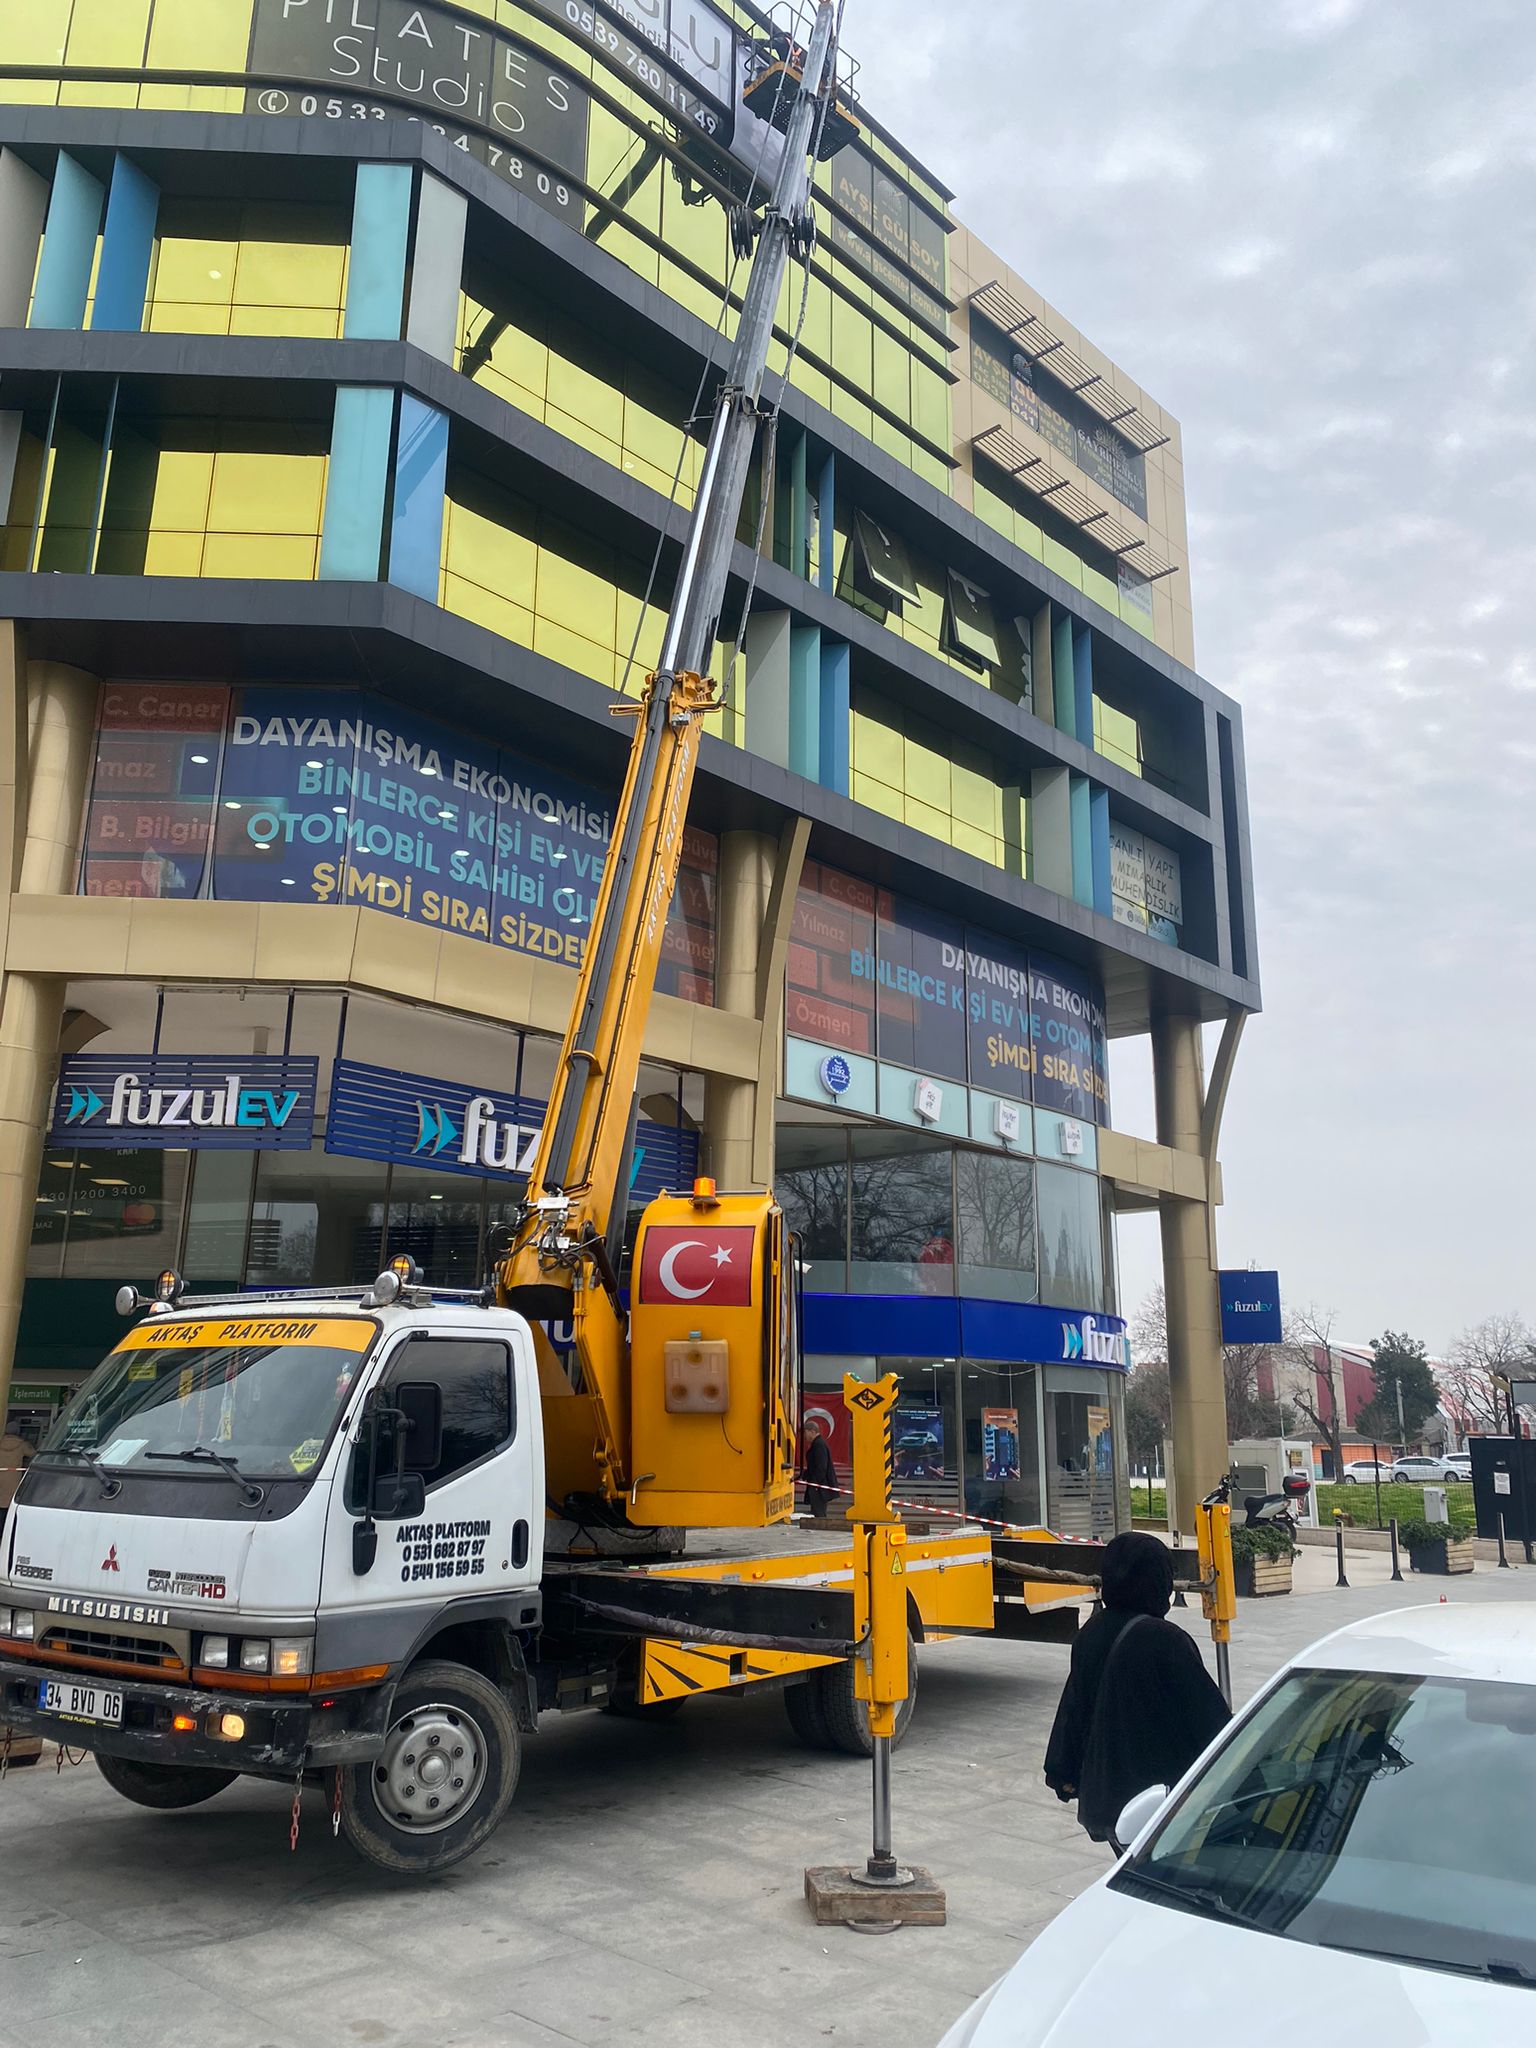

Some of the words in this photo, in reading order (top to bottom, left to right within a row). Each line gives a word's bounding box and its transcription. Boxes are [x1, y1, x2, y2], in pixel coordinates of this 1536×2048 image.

[329, 35, 525, 133] Studio
[565, 0, 620, 52] 0539
[625, 46, 662, 90] 780
[667, 83, 687, 113] 11
[694, 109, 717, 135] 49
[488, 144, 524, 180] 78
[536, 172, 570, 206] 09
[231, 714, 445, 782] DAYANIŞMA
[452, 757, 612, 844] EKONOMİSİ
[297, 756, 459, 834] BİNLERCE
[467, 810, 522, 858] KİŞİ
[530, 833, 567, 871] EV
[571, 849, 606, 885] VE
[246, 811, 441, 875] OTOMOBİL
[449, 852, 545, 909] SAHİBİ
[310, 853, 413, 914] ŞİMDİ
[421, 890, 492, 939] SIRA
[799, 909, 846, 943] Yılmaz
[850, 947, 947, 1007] BİNLERCE
[990, 999, 1014, 1029] EV
[941, 942, 1049, 1004] DAYANIŞMA
[986, 1032, 1038, 1075] ŞİMDİ
[1042, 1053, 1081, 1089] SIRA
[105, 1072, 301, 1127] fuzulEV
[73, 1188, 106, 1201] 1200
[111, 1184, 147, 1197] 3400
[264, 1291, 298, 1300] HYZ
[1233, 1300, 1273, 1313] fuzulEV
[146, 1324, 204, 1344] AKTAŞ
[218, 1322, 319, 1340] PLATFORM
[396, 1523, 434, 1544] AKTAŞ
[435, 1520, 491, 1540] PLATFORM
[402, 1545, 412, 1562] 0
[413, 1543, 433, 1561] 531
[433, 1541, 456, 1560] 682
[456, 1540, 471, 1558] 87
[471, 1539, 486, 1556] 97
[401, 1565, 411, 1583] 0
[411, 1563, 434, 1581] 544
[435, 1561, 454, 1579] 156
[455, 1559, 470, 1577] 59
[470, 1558, 485, 1575] 55
[48, 1596, 170, 1626] MITSUBISHI
[46, 1684, 62, 1709] 34
[103, 1693, 121, 1719] 06
